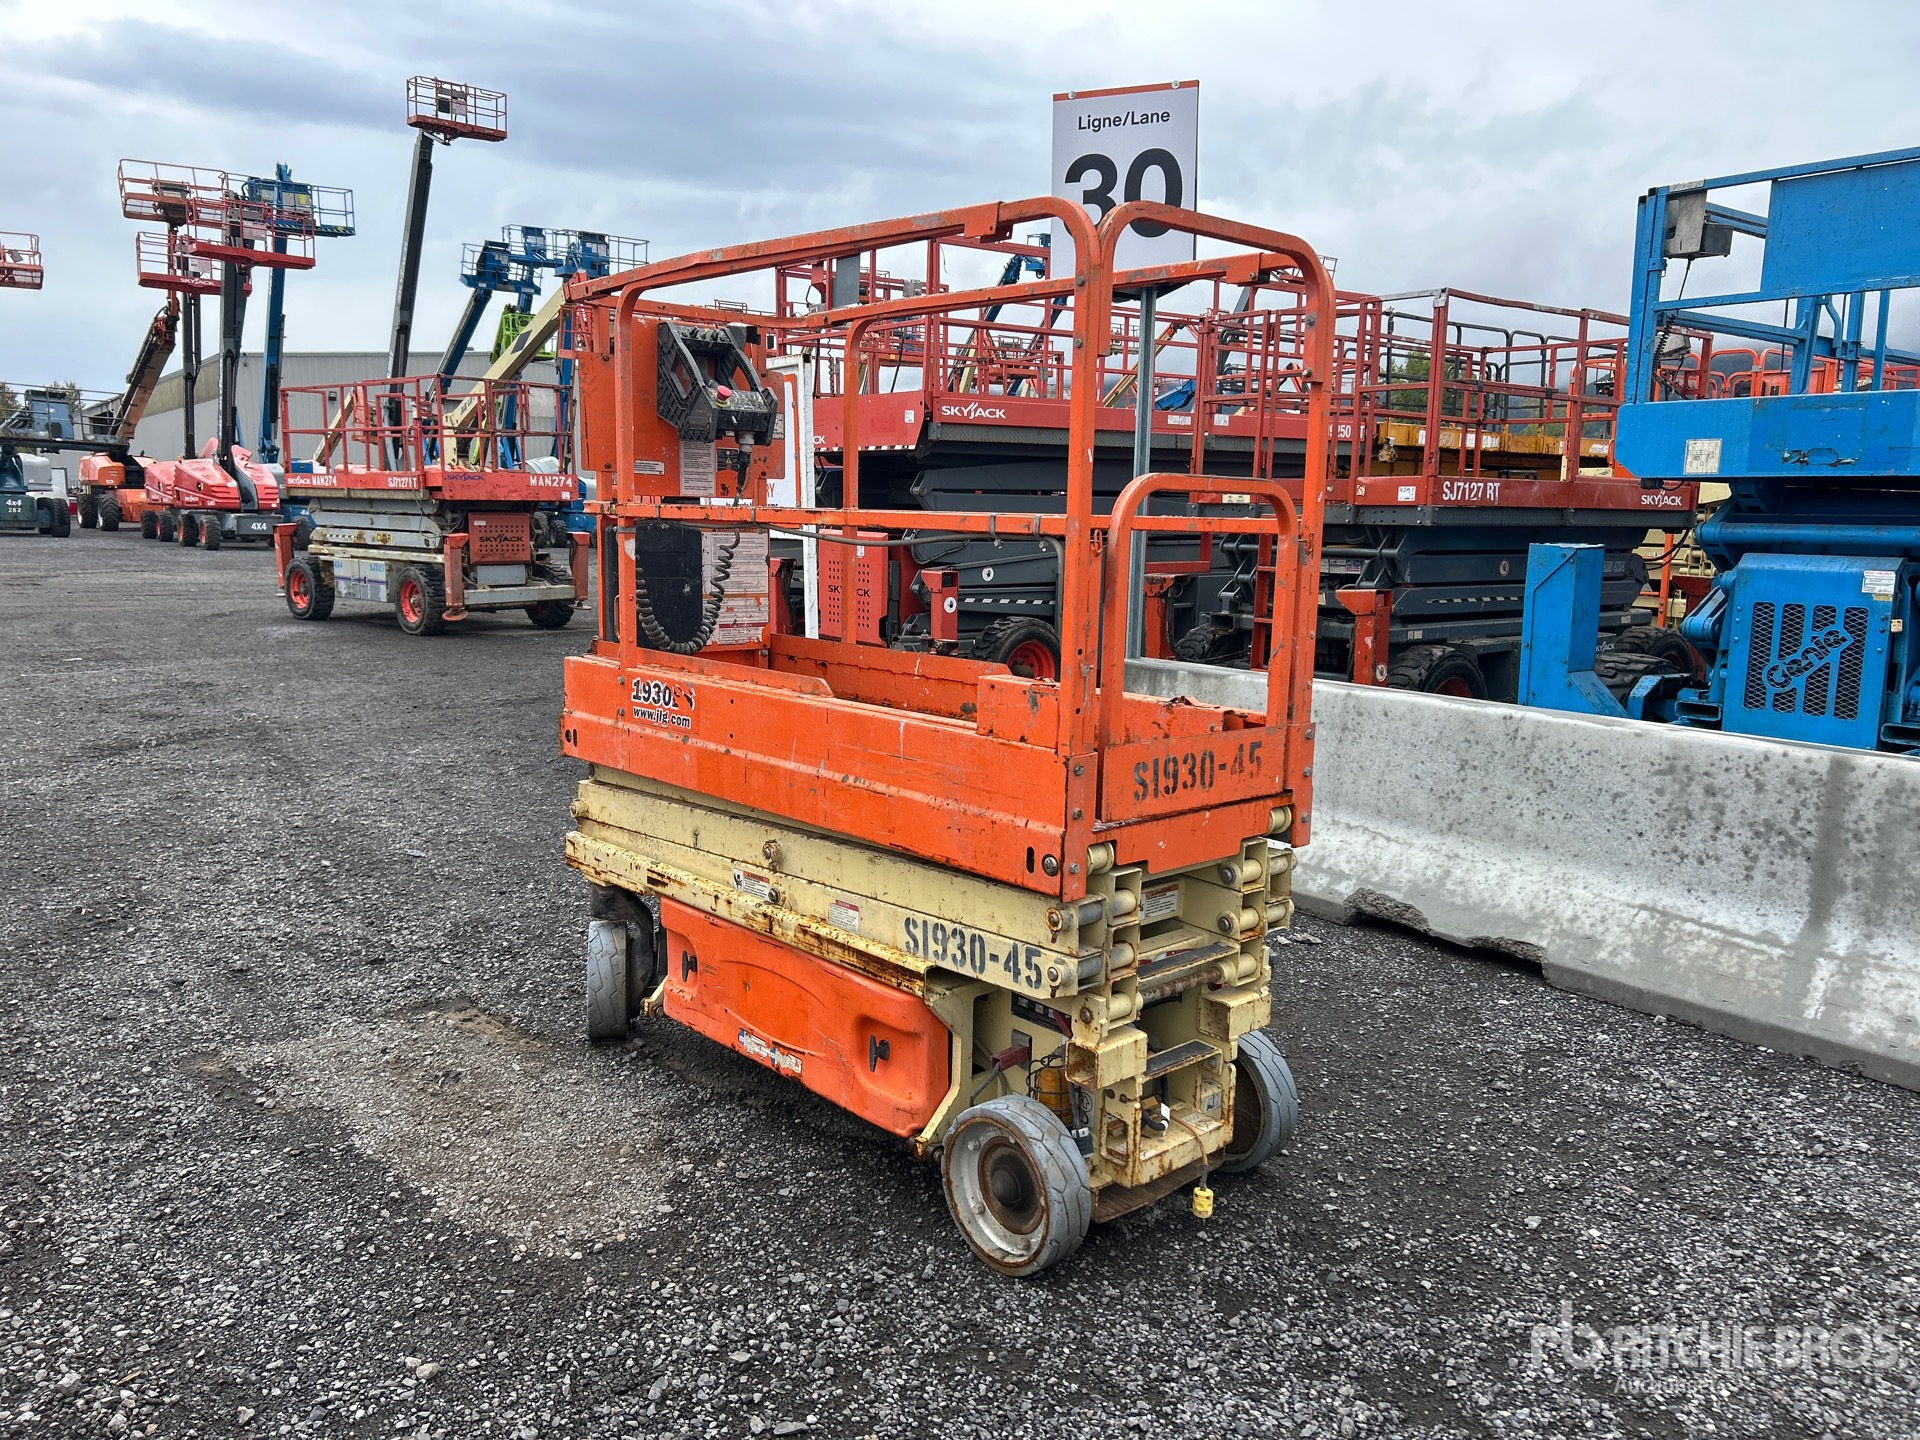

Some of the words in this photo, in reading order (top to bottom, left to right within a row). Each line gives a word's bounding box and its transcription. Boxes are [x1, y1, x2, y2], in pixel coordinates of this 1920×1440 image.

[1078, 110, 1171, 132] Ligne/Lane
[1064, 147, 1183, 239] 30
[180, 277, 215, 286] SKYJACK
[941, 401, 1007, 420] SKYJACK
[287, 475, 312, 485] SKYJACK
[312, 476, 337, 487] MAN274
[446, 472, 485, 481] SKYJACK
[529, 475, 573, 488] MAN274
[1442, 480, 1484, 501] SJ7127
[1486, 481, 1501, 503] RT
[1641, 490, 1682, 508] SKYJACK
[251, 522, 267, 531] 4X4
[479, 533, 524, 544] SKYJACK
[1595, 641, 1616, 653] KYJACK
[1766, 628, 1849, 689] Genie
[632, 706, 692, 729] www.jlg.com
[1132, 740, 1263, 802] S1930-45
[903, 916, 1043, 990] S1930-45
